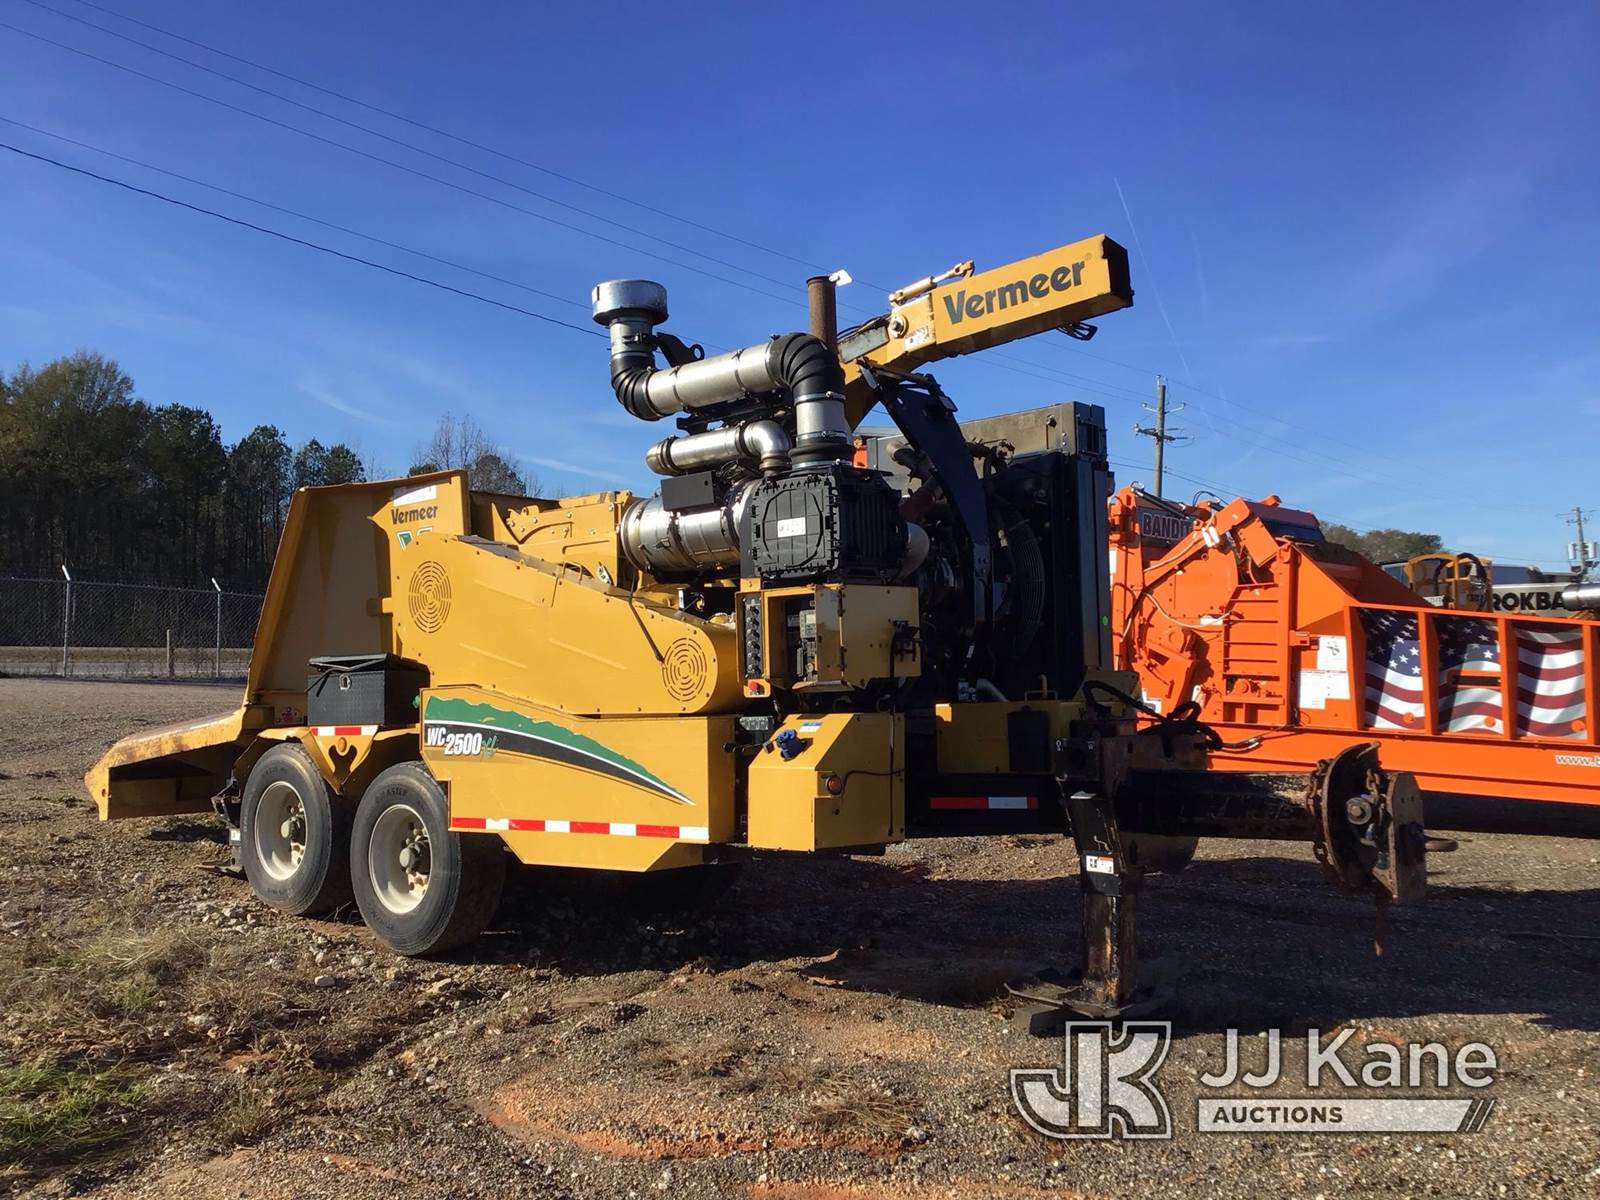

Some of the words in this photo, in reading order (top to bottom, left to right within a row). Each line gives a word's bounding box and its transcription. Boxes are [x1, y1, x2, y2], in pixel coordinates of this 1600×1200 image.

[943, 260, 1085, 325] Vermeer
[391, 505, 438, 525] Vermeer
[1493, 591, 1564, 612] ROKBA
